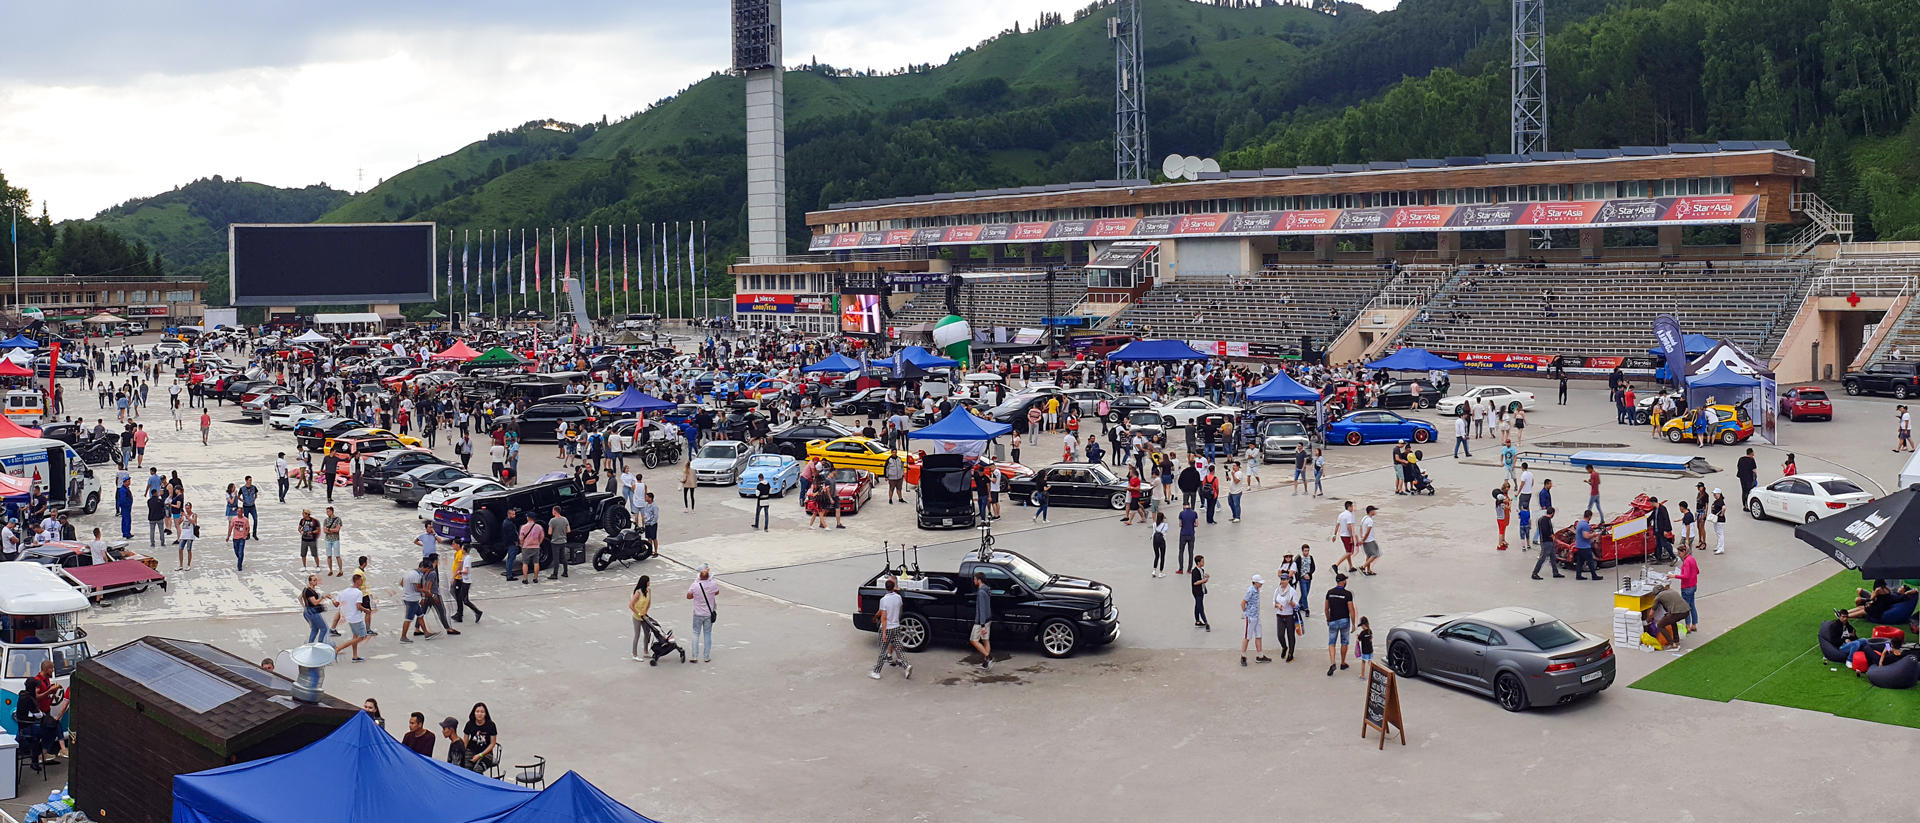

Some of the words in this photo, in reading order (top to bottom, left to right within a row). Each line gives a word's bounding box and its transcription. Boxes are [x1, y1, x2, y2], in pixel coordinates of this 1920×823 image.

[1618, 207, 1634, 215] Star
[1637, 206, 1655, 214] Asia
[1693, 204, 1710, 212] Star
[1713, 203, 1732, 212] Asia
